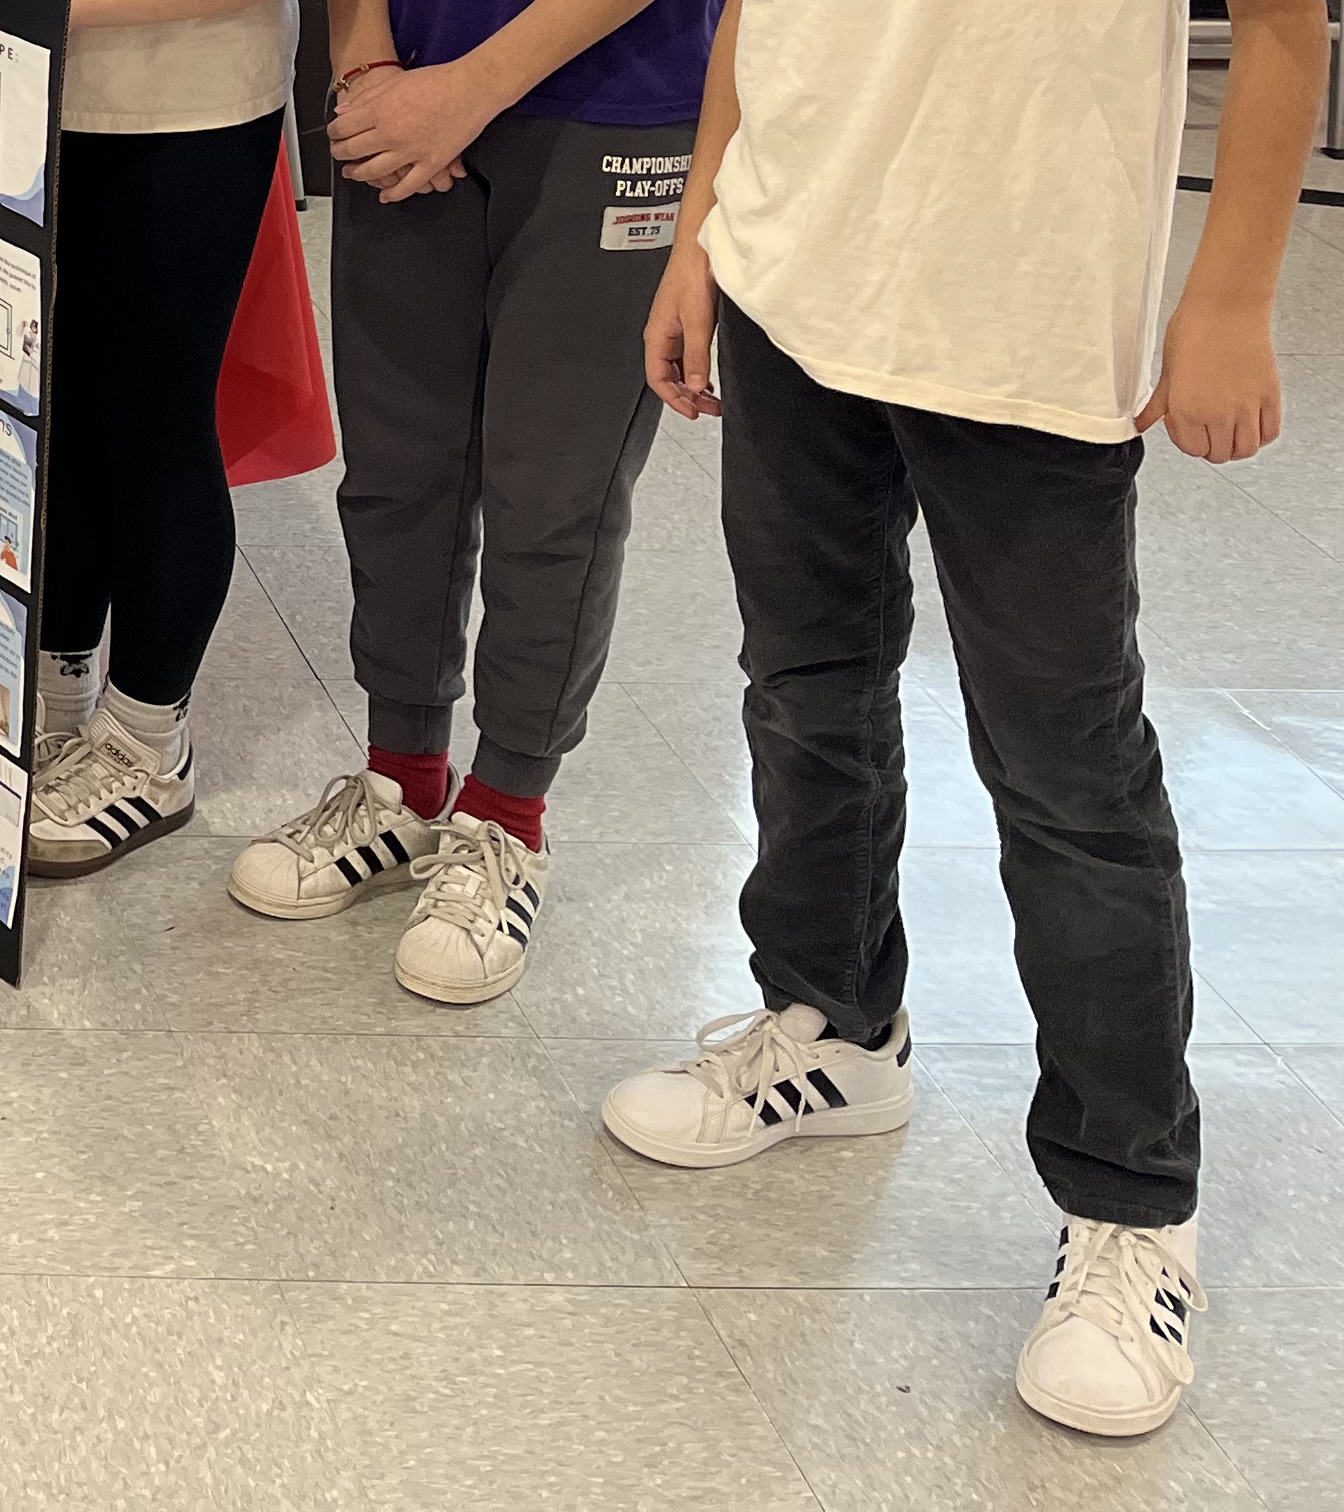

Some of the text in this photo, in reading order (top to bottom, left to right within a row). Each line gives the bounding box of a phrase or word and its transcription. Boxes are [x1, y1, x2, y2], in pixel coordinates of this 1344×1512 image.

[602, 154, 693, 175] CHAMPIONSHI
[615, 177, 684, 197] PLAY-OFFS
[628, 227, 648, 237] EST
[105, 743, 134, 768] adidas
